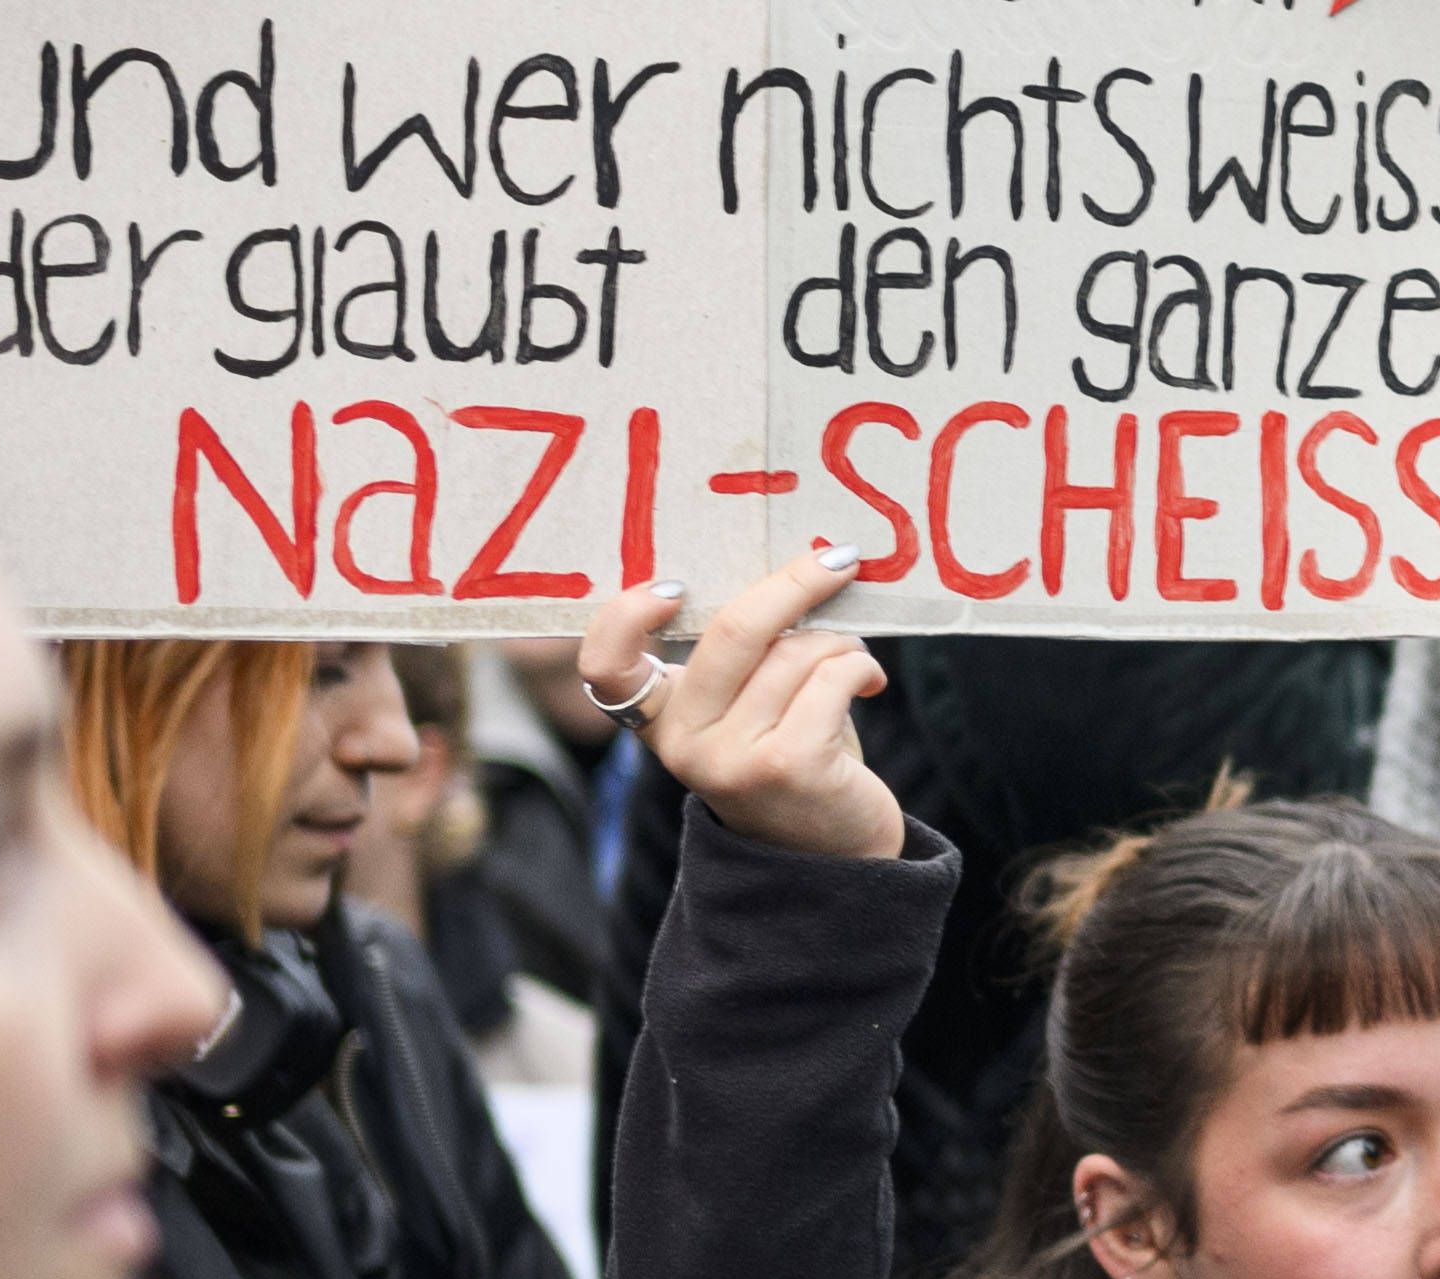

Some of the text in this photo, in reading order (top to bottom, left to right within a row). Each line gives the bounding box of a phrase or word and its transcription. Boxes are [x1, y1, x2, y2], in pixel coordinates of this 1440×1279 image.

[343, 54, 679, 209] wer
[720, 34, 1154, 226] nichts
[214, 221, 646, 379] glaubt
[783, 223, 1016, 377] den
